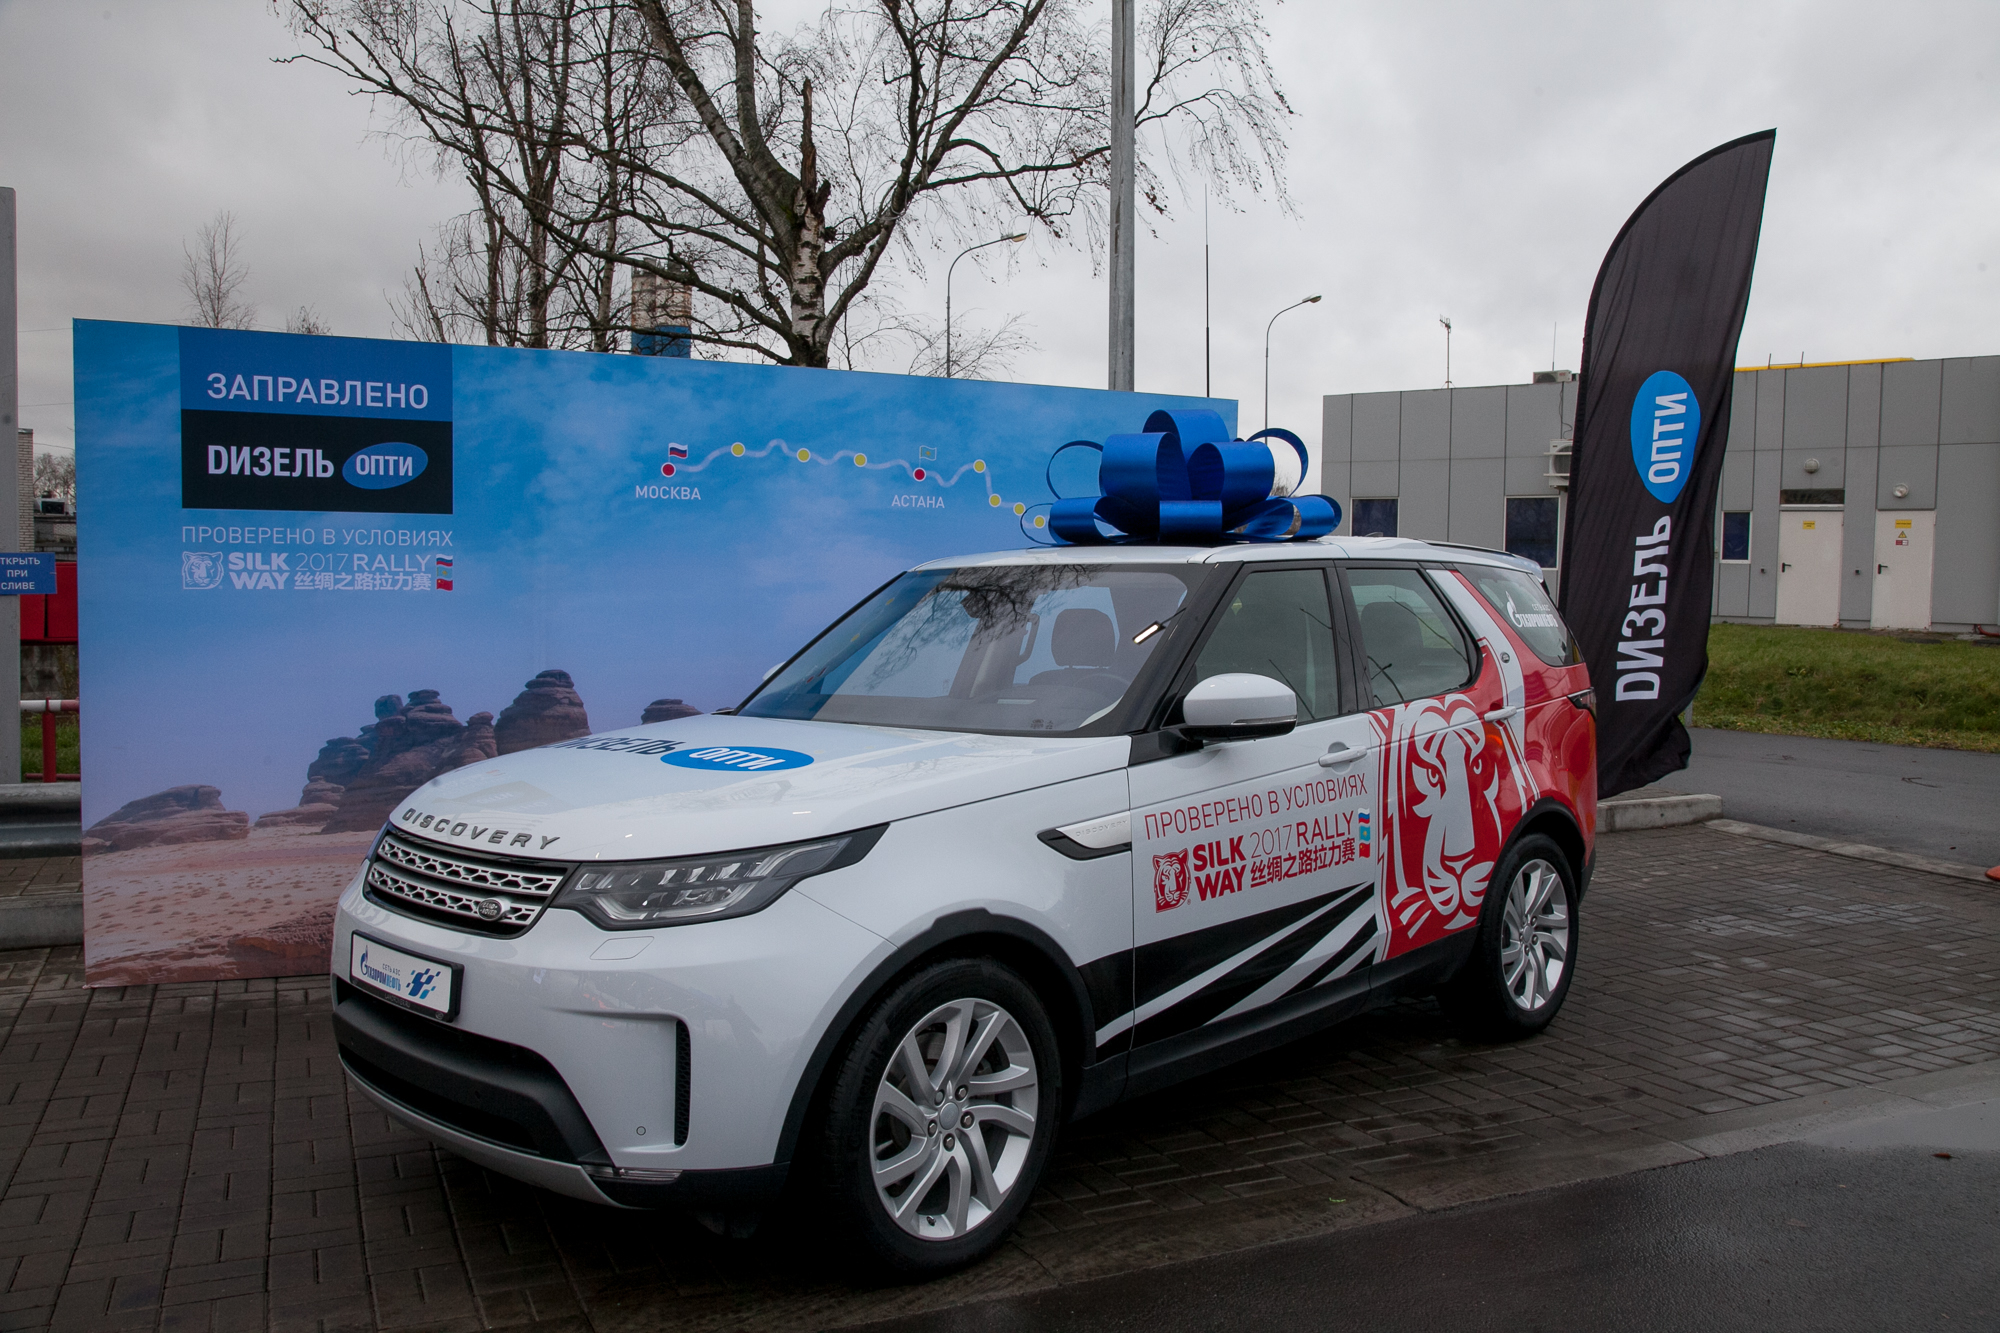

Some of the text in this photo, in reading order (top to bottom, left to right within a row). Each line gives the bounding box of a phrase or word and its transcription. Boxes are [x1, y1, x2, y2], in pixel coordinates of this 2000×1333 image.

[207, 372, 429, 409] ЗАПРАВЛЕНО
[1648, 392, 1688, 484] ОПТИ
[355, 454, 413, 477] ОПТИ
[635, 485, 701, 501] МОСКВА
[891, 494, 945, 509] АСТАНА
[181, 526, 453, 547] ПРОВЕРЕНО В УСЛОВИЯХ
[0, 557, 41, 565] ТКРЫТЬ
[228, 552, 431, 572] SILK 2017 RALLY
[7, 569, 28, 577] ПРИ
[229, 571, 290, 590] WAY
[294, 571, 431, 592] 丝绸之路拉力赛
[1, 582, 35, 590] СЛИВЕ
[689, 747, 786, 770] ОПТИ
[1144, 773, 1368, 840] ПРОВЕРЕНО В УСЛОВИЯХ
[402, 808, 561, 850] DISCOVERY
[1193, 810, 1355, 872] SILK 2017 RALLY
[1250, 837, 1356, 888] 丝绸之路拉力赛
[1194, 864, 1247, 901] WAY
